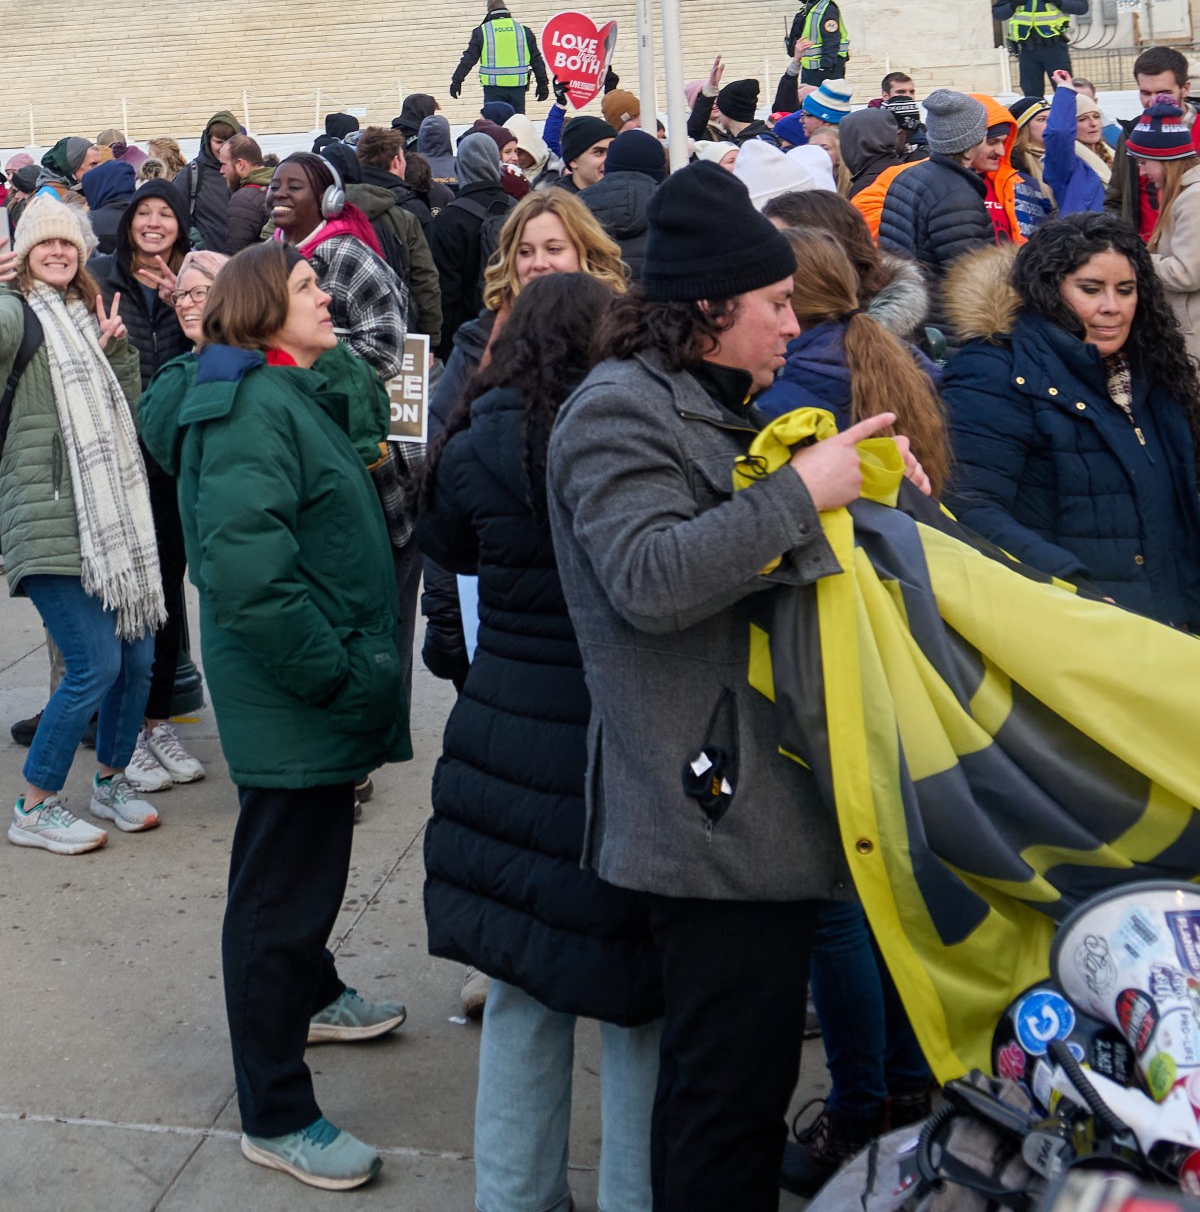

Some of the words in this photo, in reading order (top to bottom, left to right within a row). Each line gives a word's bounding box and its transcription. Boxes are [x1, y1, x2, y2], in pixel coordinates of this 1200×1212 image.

[552, 30, 599, 54] LOVE
[554, 52, 601, 75] BOTH
[1180, 1013, 1194, 1062] PRO-LIFE
